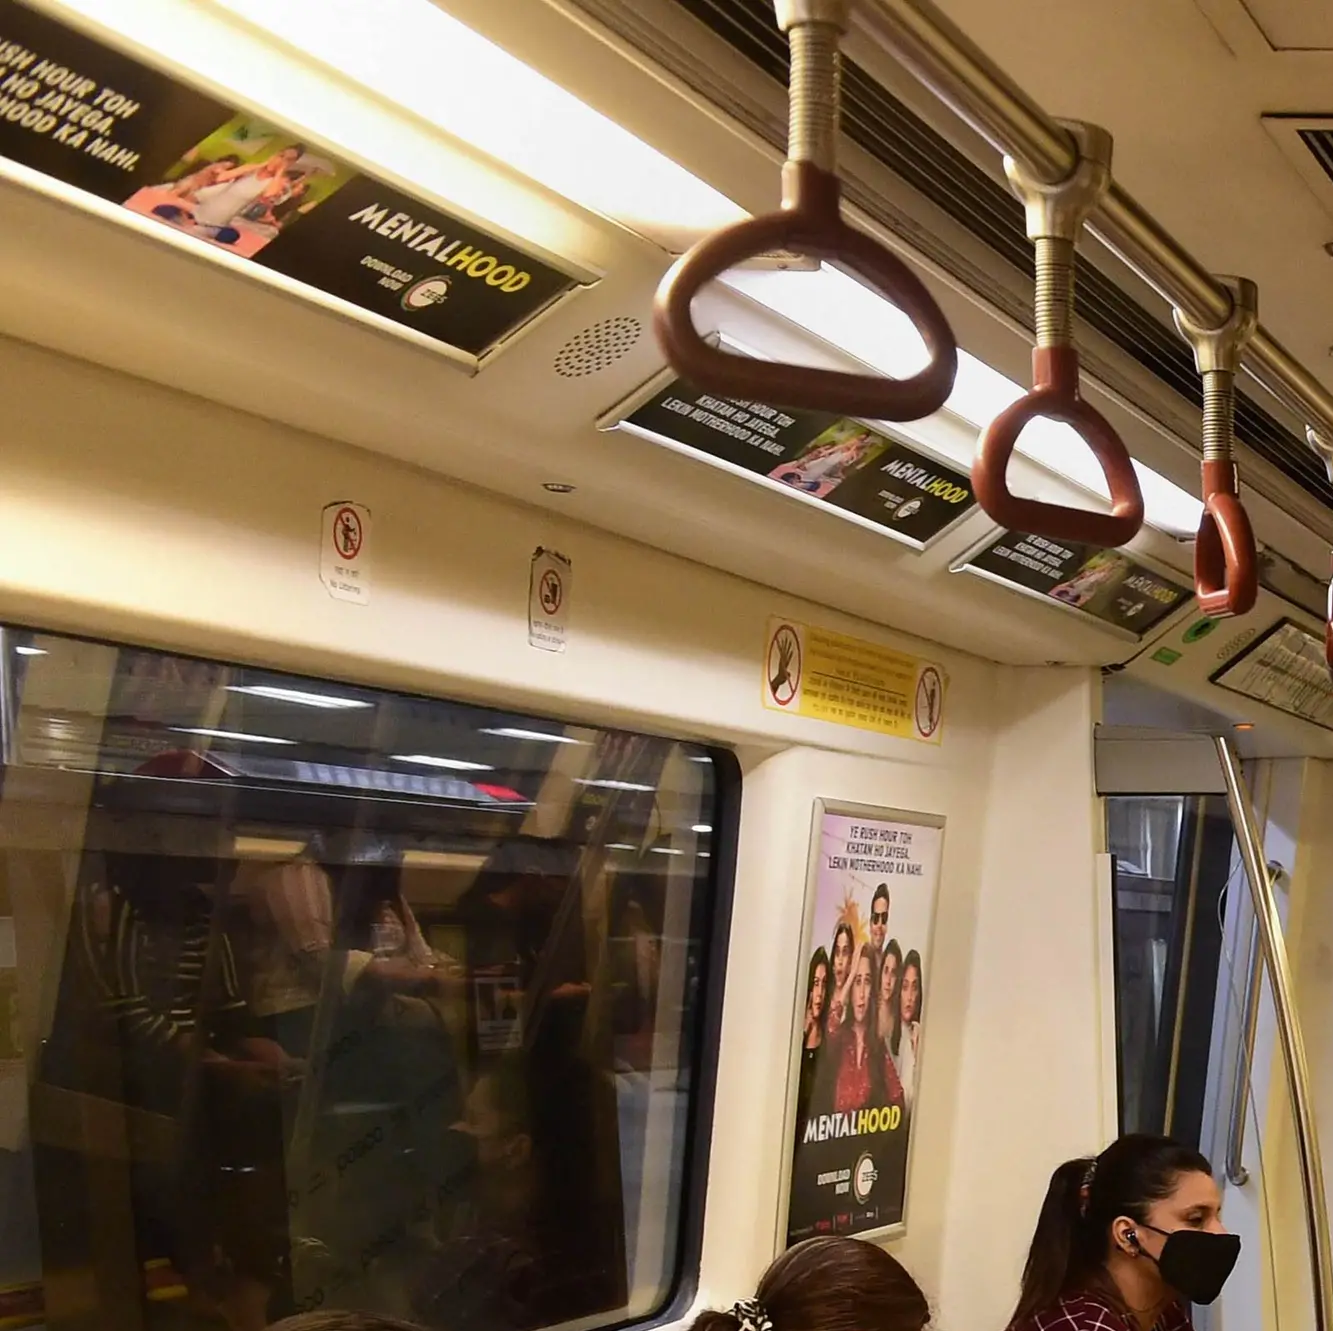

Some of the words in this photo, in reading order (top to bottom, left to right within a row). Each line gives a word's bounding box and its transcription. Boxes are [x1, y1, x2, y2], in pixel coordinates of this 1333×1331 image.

[29, 58, 96, 99] HOUR
[93, 88, 140, 119] TOH
[52, 122, 88, 148] KA
[348, 203, 531, 293] MENTALHOOD
[880, 459, 968, 504] MENTALHOOD
[803, 1105, 901, 1144] MENTALHOOD
